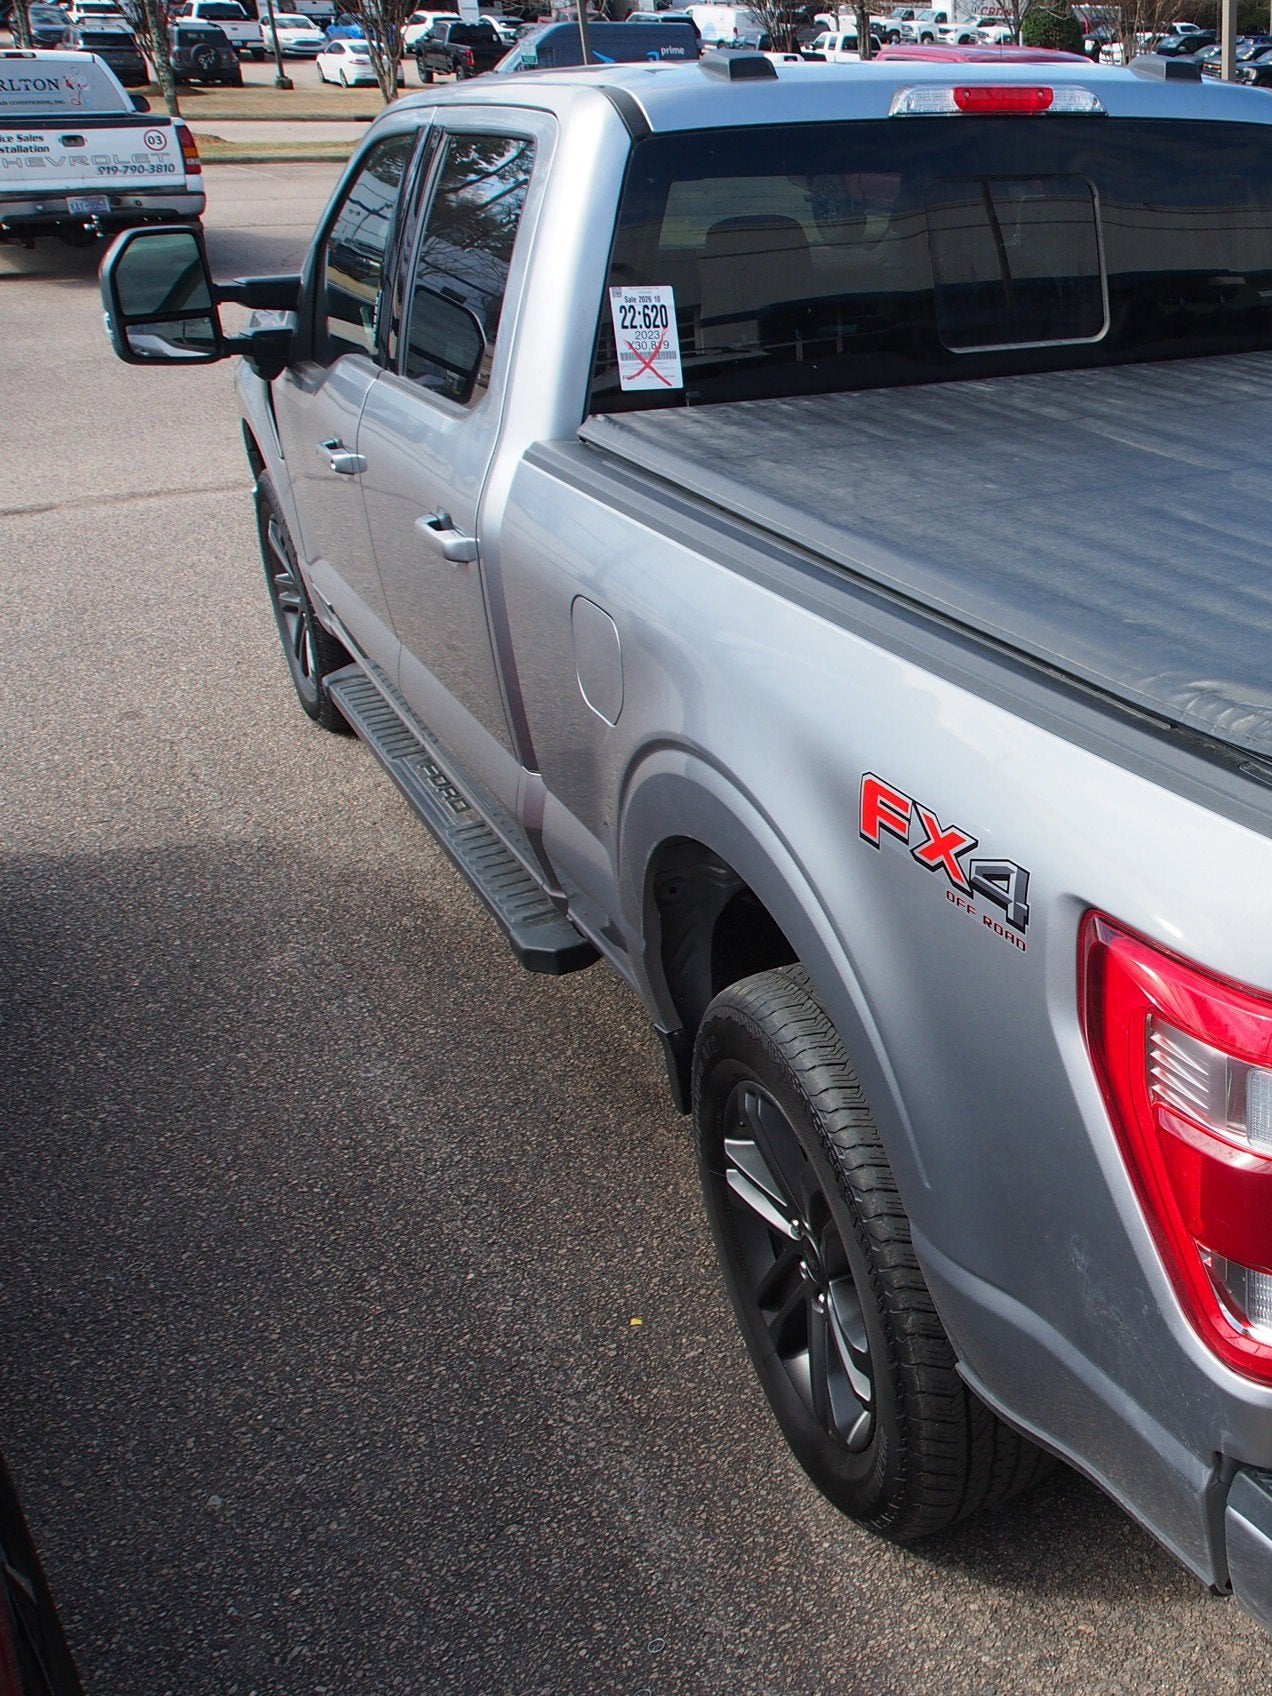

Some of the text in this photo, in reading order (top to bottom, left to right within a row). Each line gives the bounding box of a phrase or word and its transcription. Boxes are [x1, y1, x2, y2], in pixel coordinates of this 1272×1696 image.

[660, 45, 685, 56] prime
[16, 133, 44, 143] Sales
[147, 135, 163, 146] 03
[2, 152, 170, 169] HEVROLET
[97, 163, 176, 176] 919-790-3810
[624, 295, 637, 303] Sale
[653, 295, 661, 303] 10
[620, 304, 669, 330] 22:620
[635, 330, 660, 340] 2023
[418, 763, 472, 814] FORD
[859, 771, 1030, 935] FX4
[946, 889, 1027, 952] OFF ROAD
